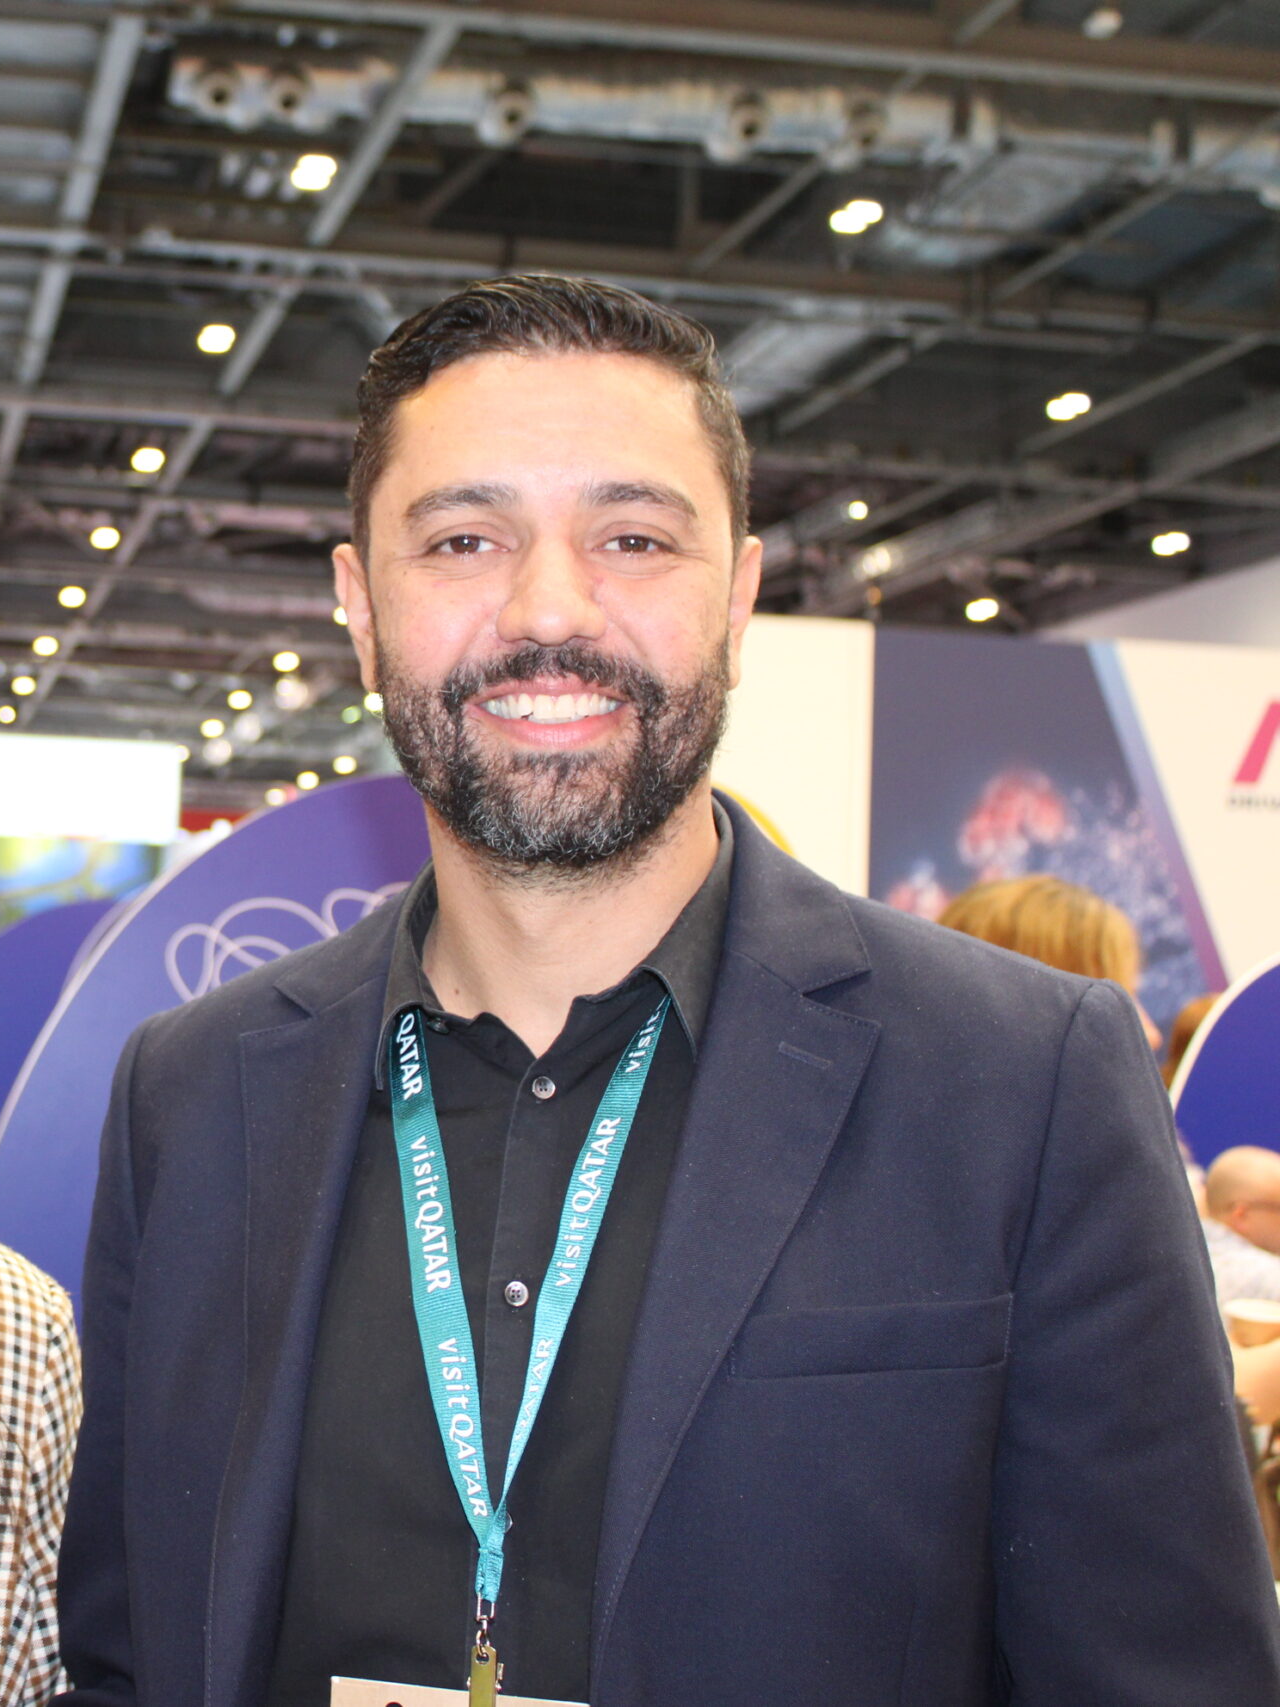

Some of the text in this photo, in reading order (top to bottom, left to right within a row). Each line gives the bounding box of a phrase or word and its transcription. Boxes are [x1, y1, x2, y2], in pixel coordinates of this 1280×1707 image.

[396, 1013, 423, 1100] QATAR
[625, 1005, 662, 1073] visit
[410, 1136, 452, 1293] visitQATAR
[555, 1117, 621, 1287] visitQATAR
[438, 1338, 488, 1517] visitQATAR
